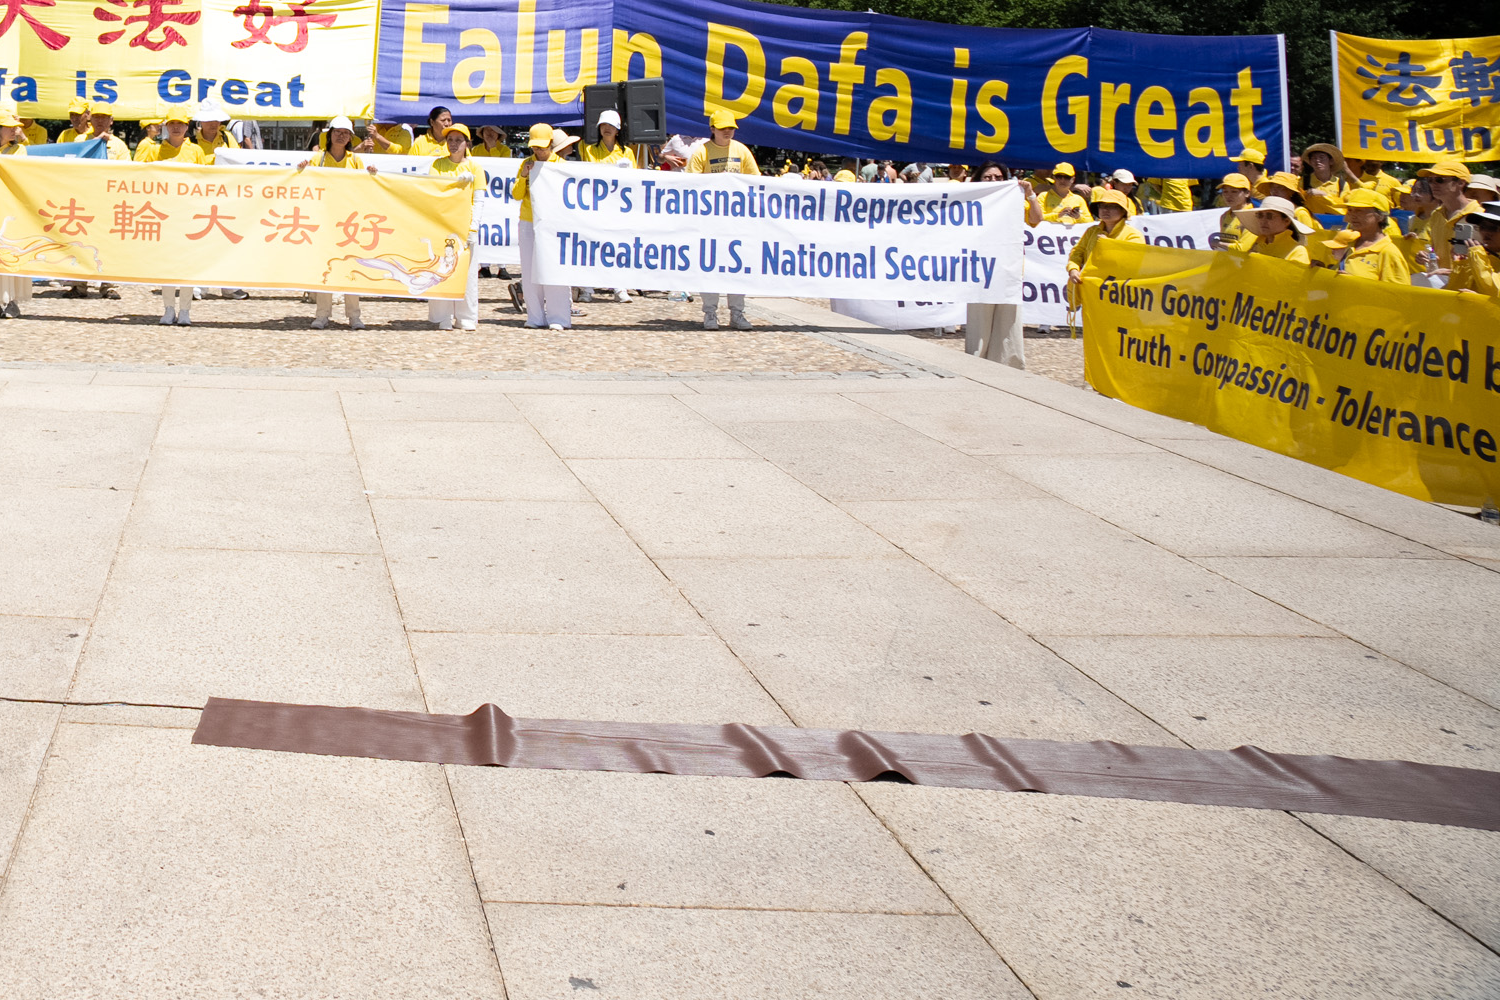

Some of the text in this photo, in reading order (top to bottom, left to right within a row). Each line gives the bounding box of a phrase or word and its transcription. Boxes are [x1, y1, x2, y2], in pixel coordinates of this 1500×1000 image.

[75, 70, 119, 104] is
[157, 69, 304, 109] Great
[703, 21, 913, 144] Dafa
[949, 47, 1010, 154] is
[1041, 55, 1268, 160] Great
[1358, 118, 1492, 152] Falun
[106, 179, 326, 201] FALUN DAFA IS GREAT
[641, 180, 827, 222] Transnational
[834, 188, 984, 230] Repression
[38, 197, 395, 251] 法輪大法好
[556, 231, 997, 290] Threatens U.S. National Security
[1100, 275, 1154, 312] Falun
[1161, 284, 1226, 331] Gong:
[1229, 292, 1358, 360] Meditation
[1364, 327, 1470, 385] Guided
[1117, 326, 1172, 369] Truth
[1193, 342, 1310, 410] Compassion
[1330, 385, 1498, 463] Tolerance
